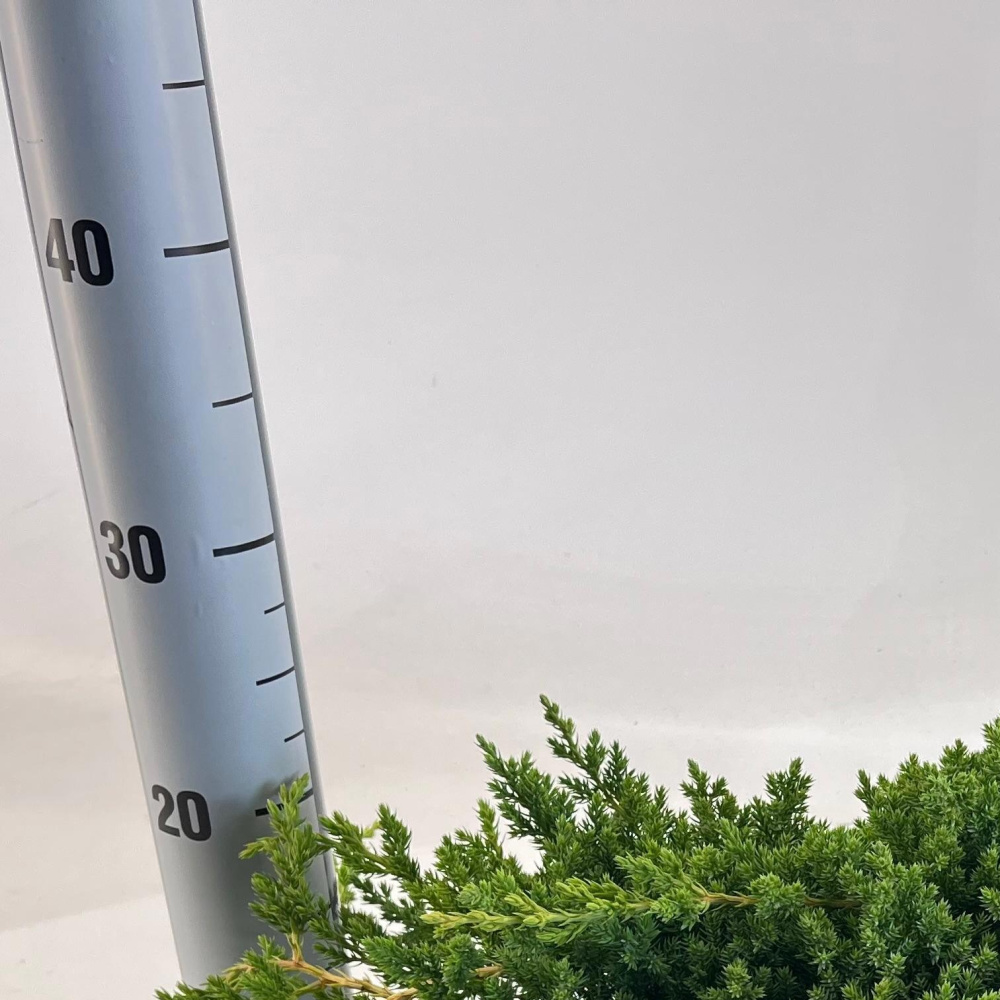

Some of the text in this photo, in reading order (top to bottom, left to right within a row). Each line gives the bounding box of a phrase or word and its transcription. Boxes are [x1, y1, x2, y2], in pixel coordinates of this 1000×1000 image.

[46, 218, 114, 286] 40
[99, 520, 166, 584] 30
[152, 784, 212, 842] 20
